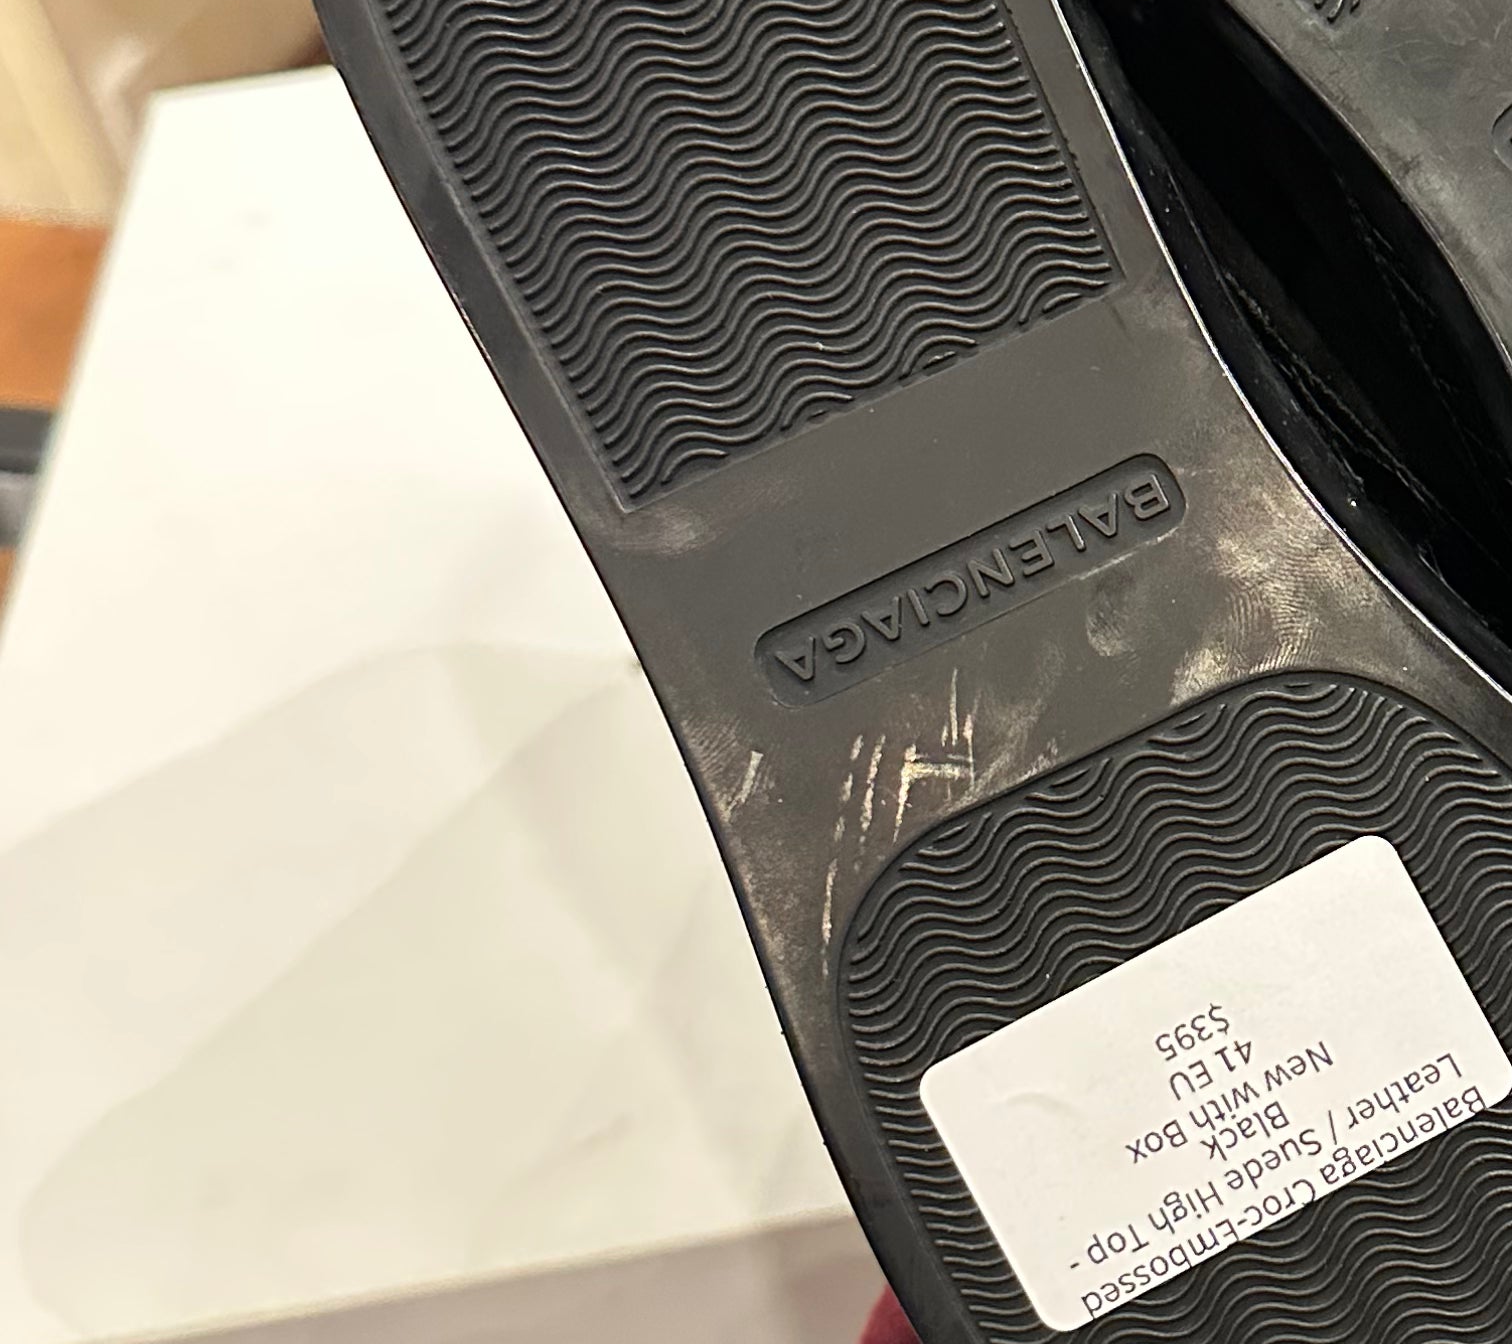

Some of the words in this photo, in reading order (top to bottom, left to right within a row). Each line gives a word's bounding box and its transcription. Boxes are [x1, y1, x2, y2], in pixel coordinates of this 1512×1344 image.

[774, 473, 1171, 682] BALENCIAGA
[1155, 1002, 1230, 1062] $395
[1214, 1041, 1252, 1073] 41
[1169, 1059, 1213, 1101] EU
[1264, 1041, 1334, 1092] New
[1348, 1054, 1462, 1129] Leather
[1188, 1081, 1260, 1131] with
[1200, 1101, 1290, 1161] Black
[1328, 1110, 1338, 1145] /
[1125, 1119, 1188, 1164] Box
[1226, 1129, 1322, 1190] Suede
[1320, 1086, 1487, 1185] Balenciaga
[1148, 1192, 1224, 1235] High
[1081, 1179, 1316, 1327] Croc-Embossed
[1087, 1224, 1150, 1265] Top
